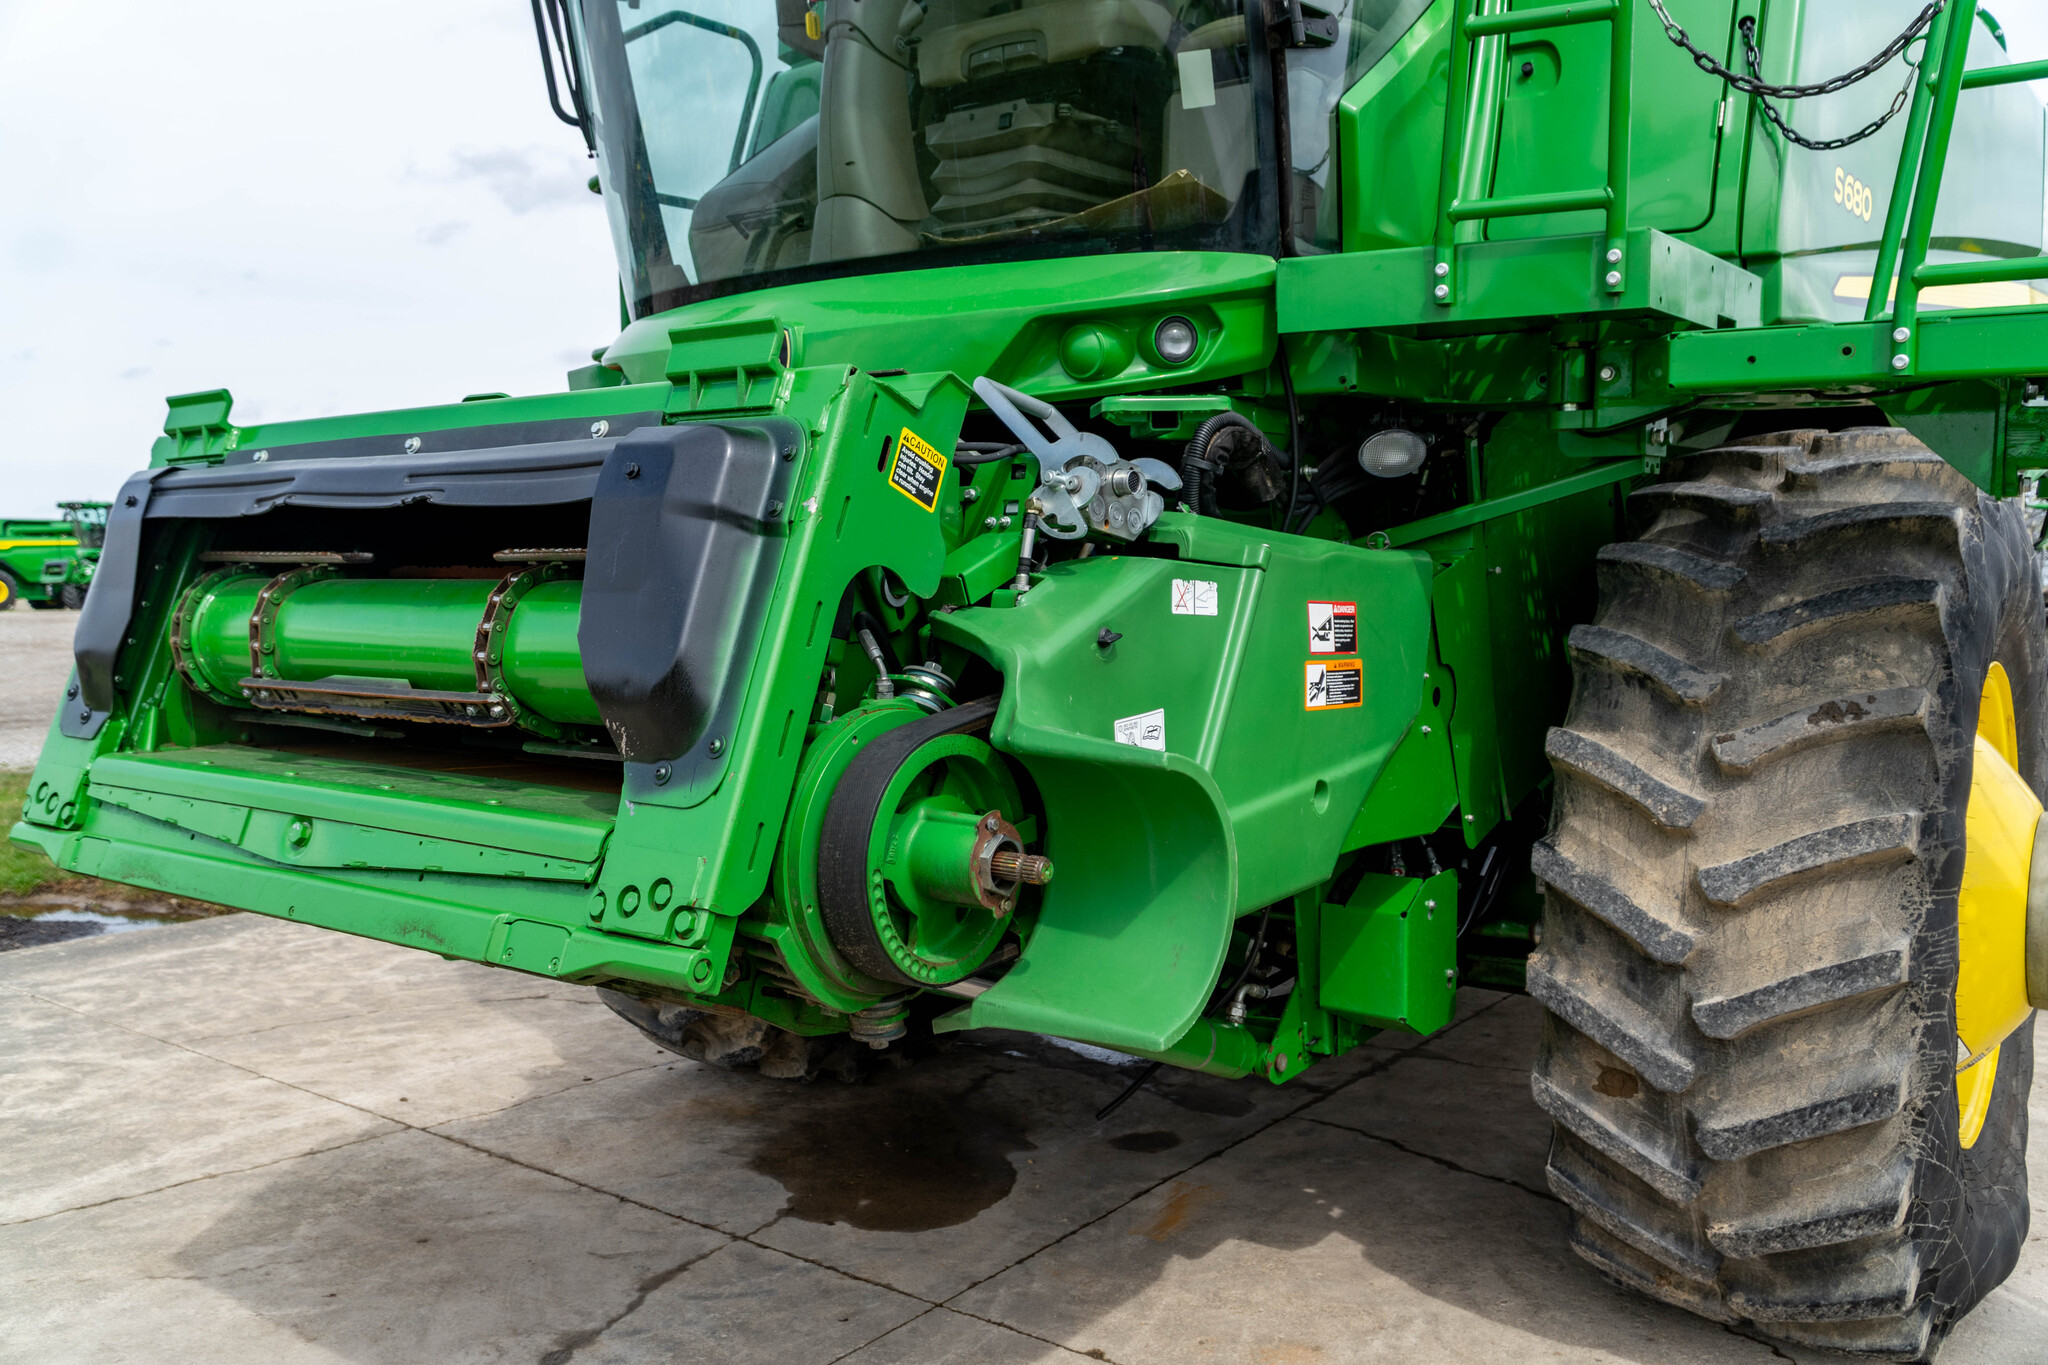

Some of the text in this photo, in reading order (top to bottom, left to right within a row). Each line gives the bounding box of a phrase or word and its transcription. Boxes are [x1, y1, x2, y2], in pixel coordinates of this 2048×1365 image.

[1834, 165, 1872, 222] S680
[902, 446, 934, 474] Avoid crushing
[910, 436, 945, 468] CAUTION
[898, 461, 907, 469] can
[907, 476, 919, 487] when
[1337, 605, 1355, 614] DANGER
